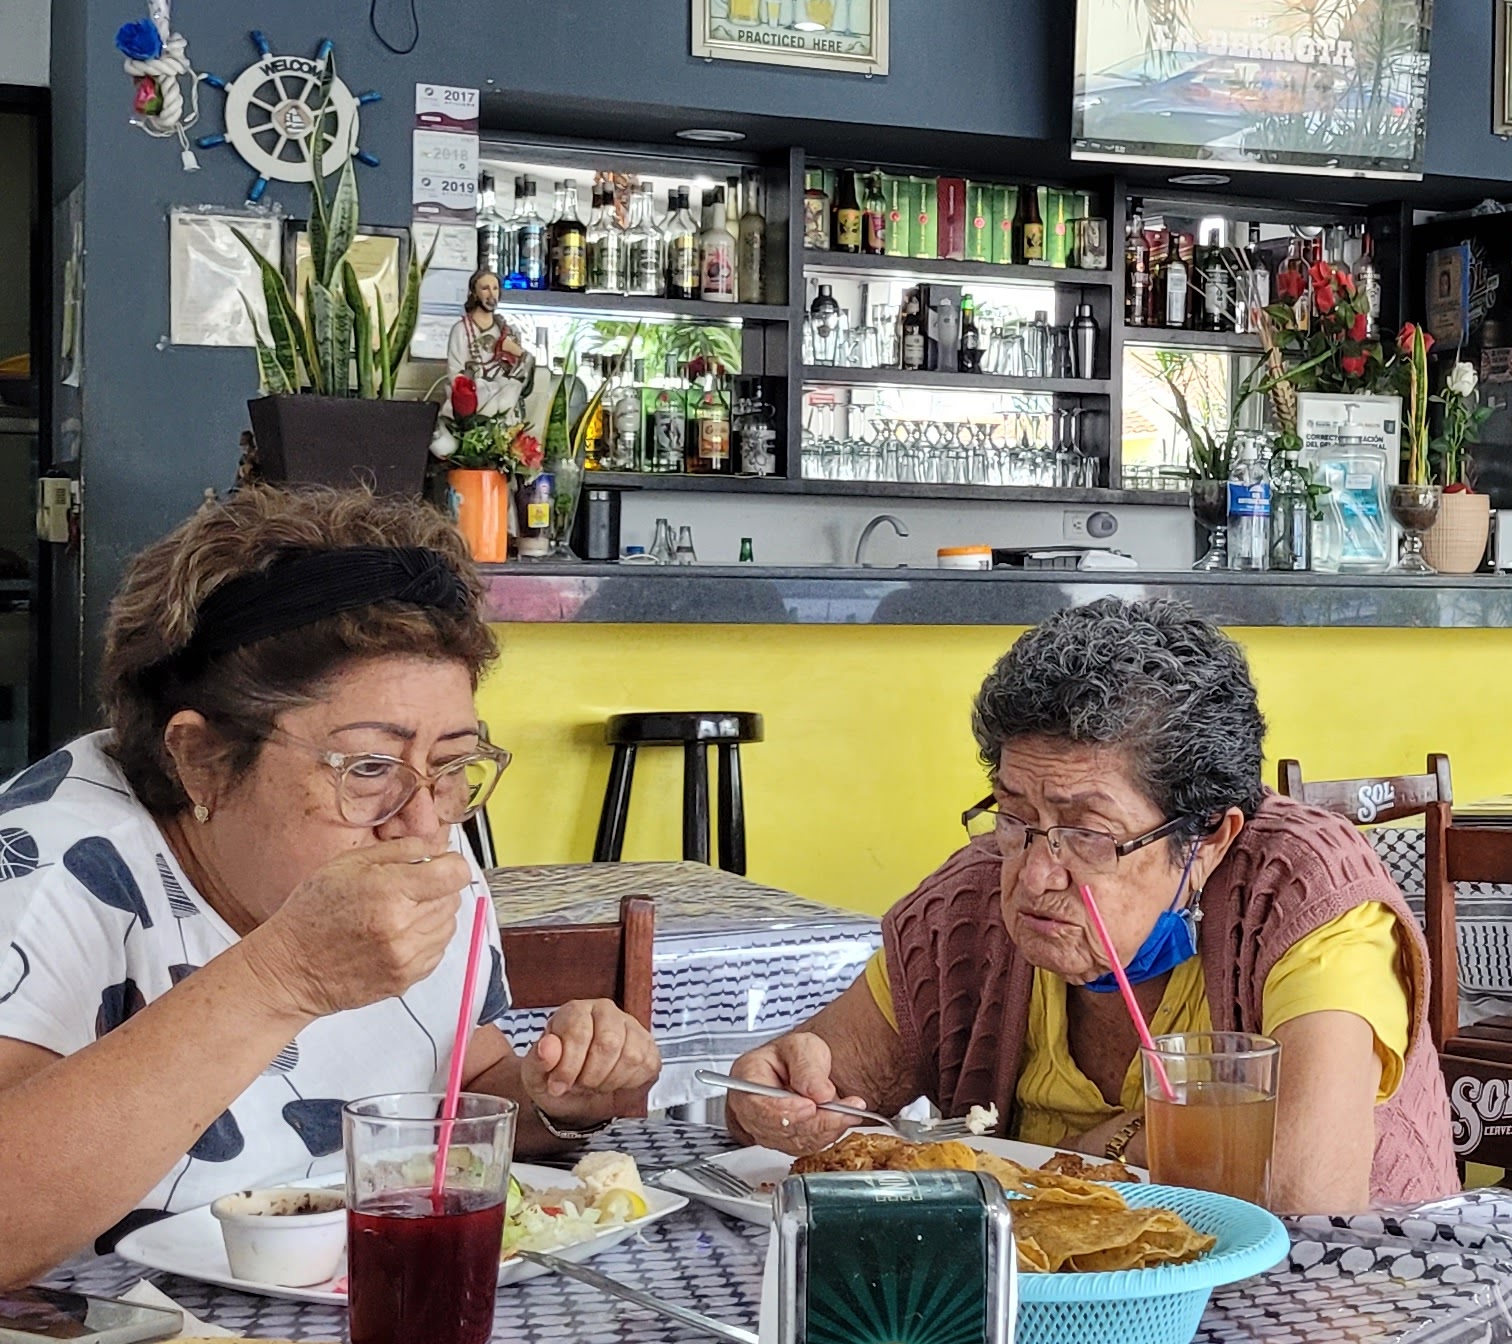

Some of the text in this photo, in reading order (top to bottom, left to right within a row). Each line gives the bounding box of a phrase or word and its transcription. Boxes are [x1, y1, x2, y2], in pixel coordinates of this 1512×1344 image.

[737, 29, 843, 52] PRACTICED HERE
[444, 89, 475, 103] 2017
[432, 146, 469, 162] 2018
[441, 180, 475, 194] 2019
[1357, 781, 1396, 823] SOL
